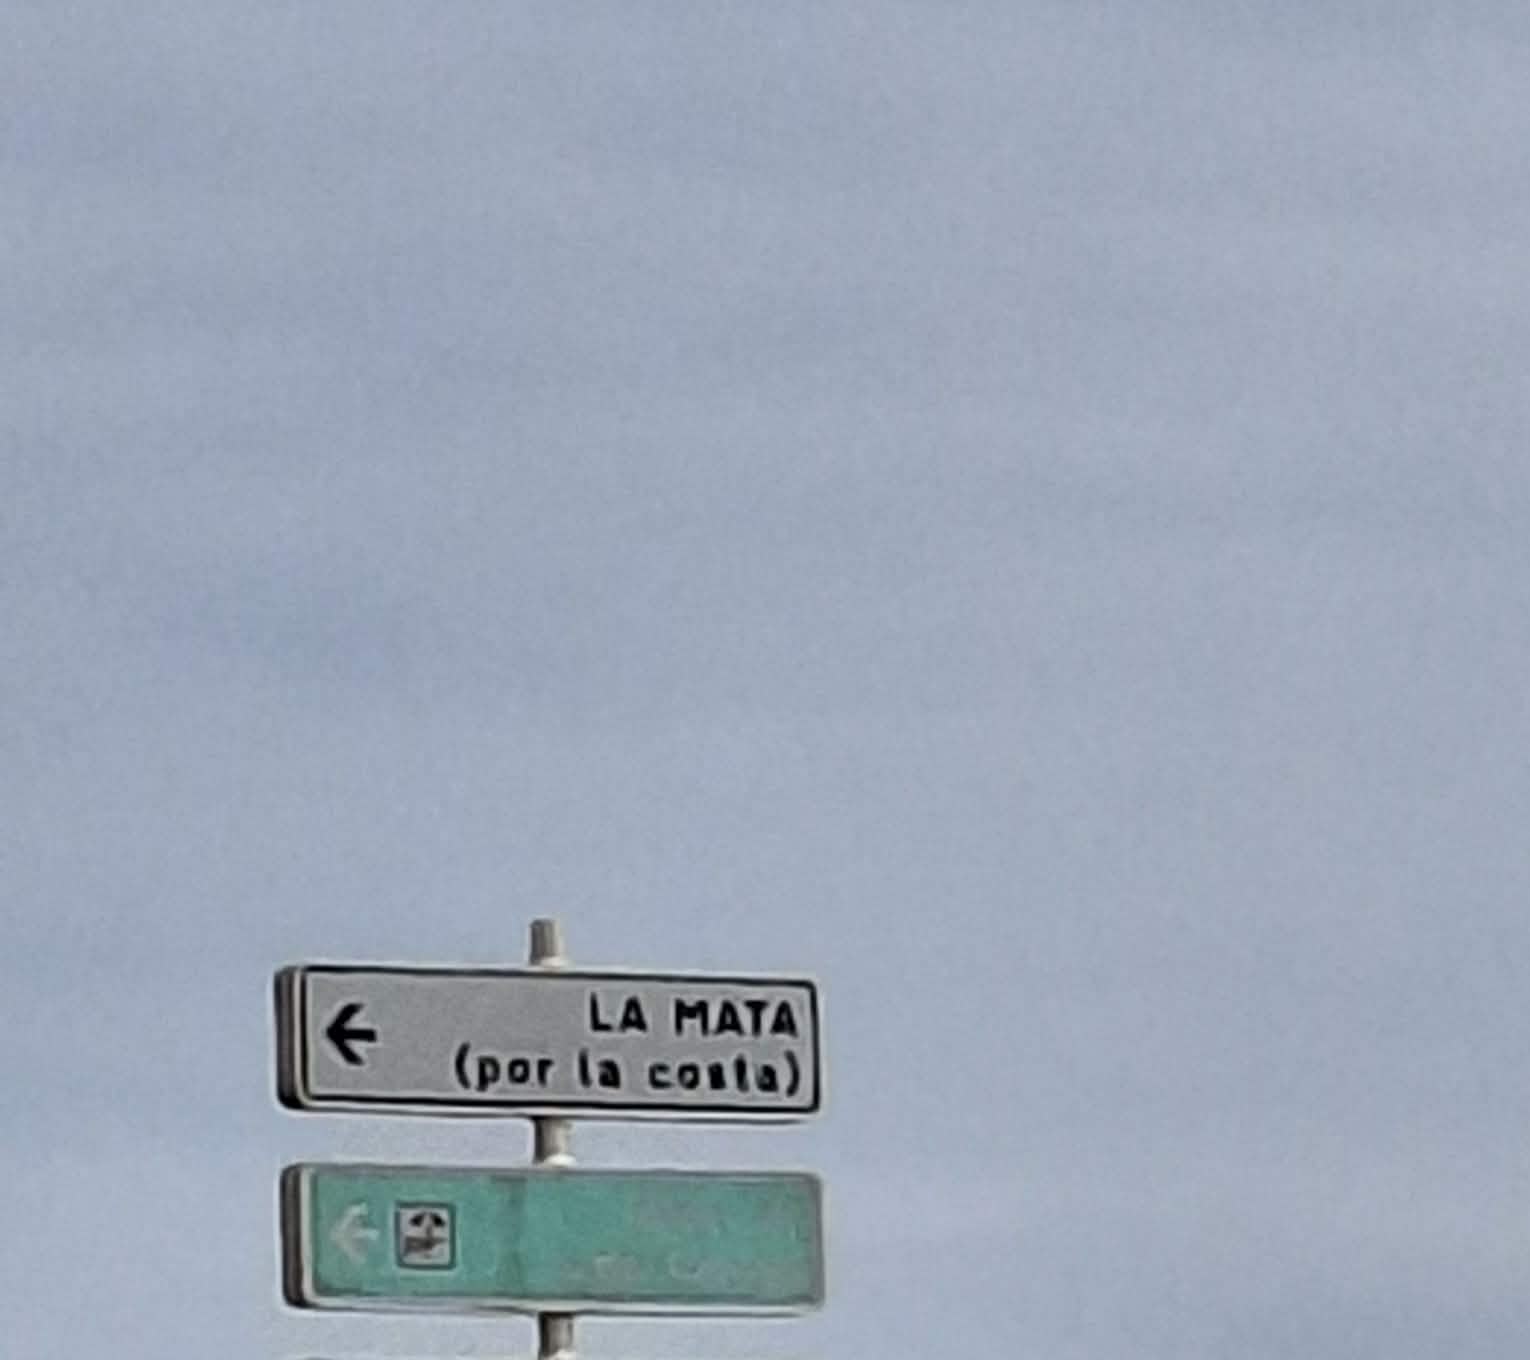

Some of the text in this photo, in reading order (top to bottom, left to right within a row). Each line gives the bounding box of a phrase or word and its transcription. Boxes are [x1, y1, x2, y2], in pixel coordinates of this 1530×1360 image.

[590, 992, 798, 1037] LA MATA
[455, 1043, 800, 1096] (por la costa)
